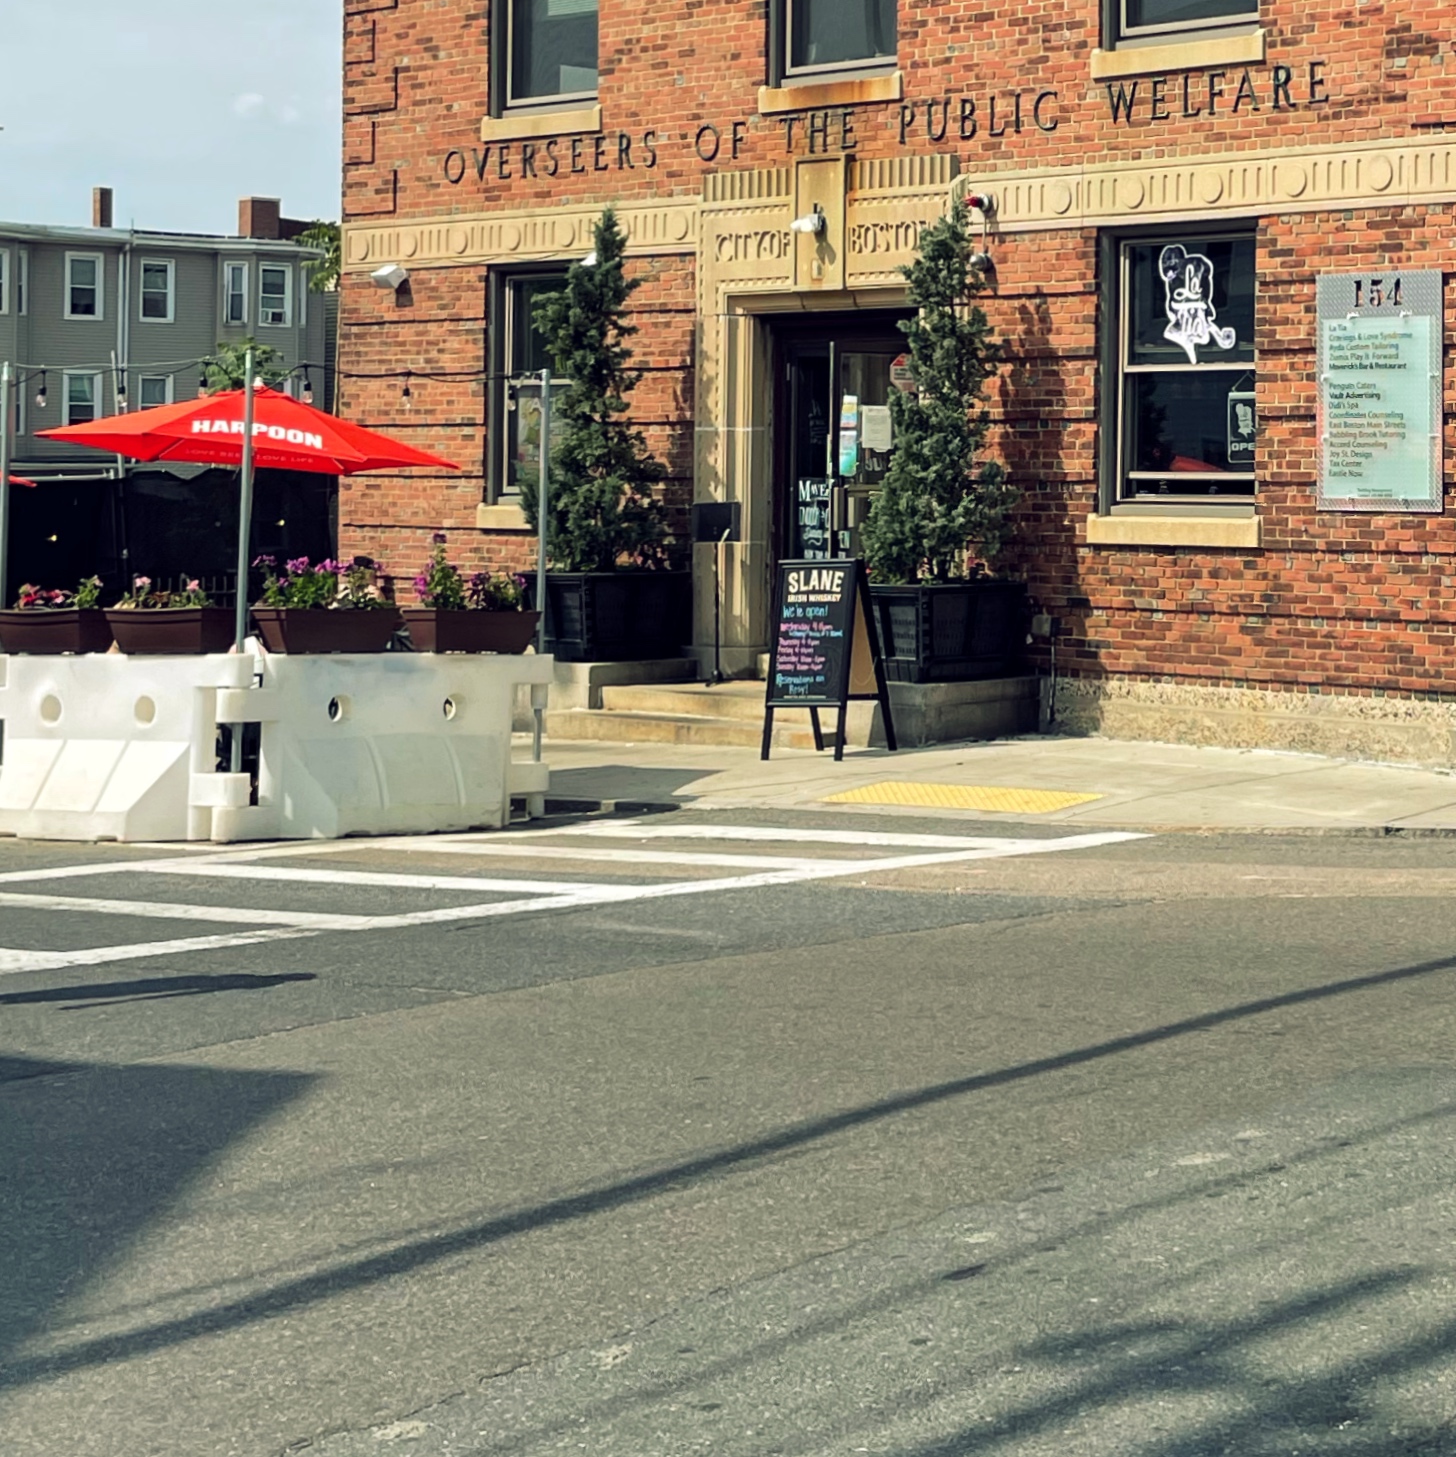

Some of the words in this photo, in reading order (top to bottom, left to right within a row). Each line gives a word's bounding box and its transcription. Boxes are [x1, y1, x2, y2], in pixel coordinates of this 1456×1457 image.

[443, 129, 658, 184] OVERSEERS
[695, 120, 746, 162] OF
[779, 107, 858, 154] THE
[898, 90, 1060, 144] PUBLIC
[1106, 60, 1330, 124] WELFARE
[1173, 264, 1203, 300] La
[1353, 277, 1404, 308] 154
[1329, 324, 1337, 332] La
[1338, 323, 1347, 332] Tia
[1371, 342, 1399, 352] Tailoring
[1350, 353, 1363, 361] Play
[1371, 352, 1399, 360] Forward
[1345, 391, 1381, 400] Advertising
[1346, 401, 1359, 410] Spa
[1368, 411, 1404, 421] Counseling
[1329, 421, 1342, 429] East
[1343, 421, 1366, 429] Boston
[1366, 421, 1383, 429] Main
[1383, 420, 1406, 429] Streets
[191, 419, 323, 450] HARPOON
[1231, 442, 1255, 451] OPE
[220, 450, 242, 459] BEE
[1329, 450, 1340, 459] Joy
[1350, 450, 1373, 459] Design
[1329, 459, 1340, 467] Tax
[1341, 459, 1362, 467] Center
[788, 569, 845, 593] SLANE
[787, 594, 808, 602] IRISH
[808, 594, 842, 602] WHISKEY
[805, 604, 829, 620] open!
